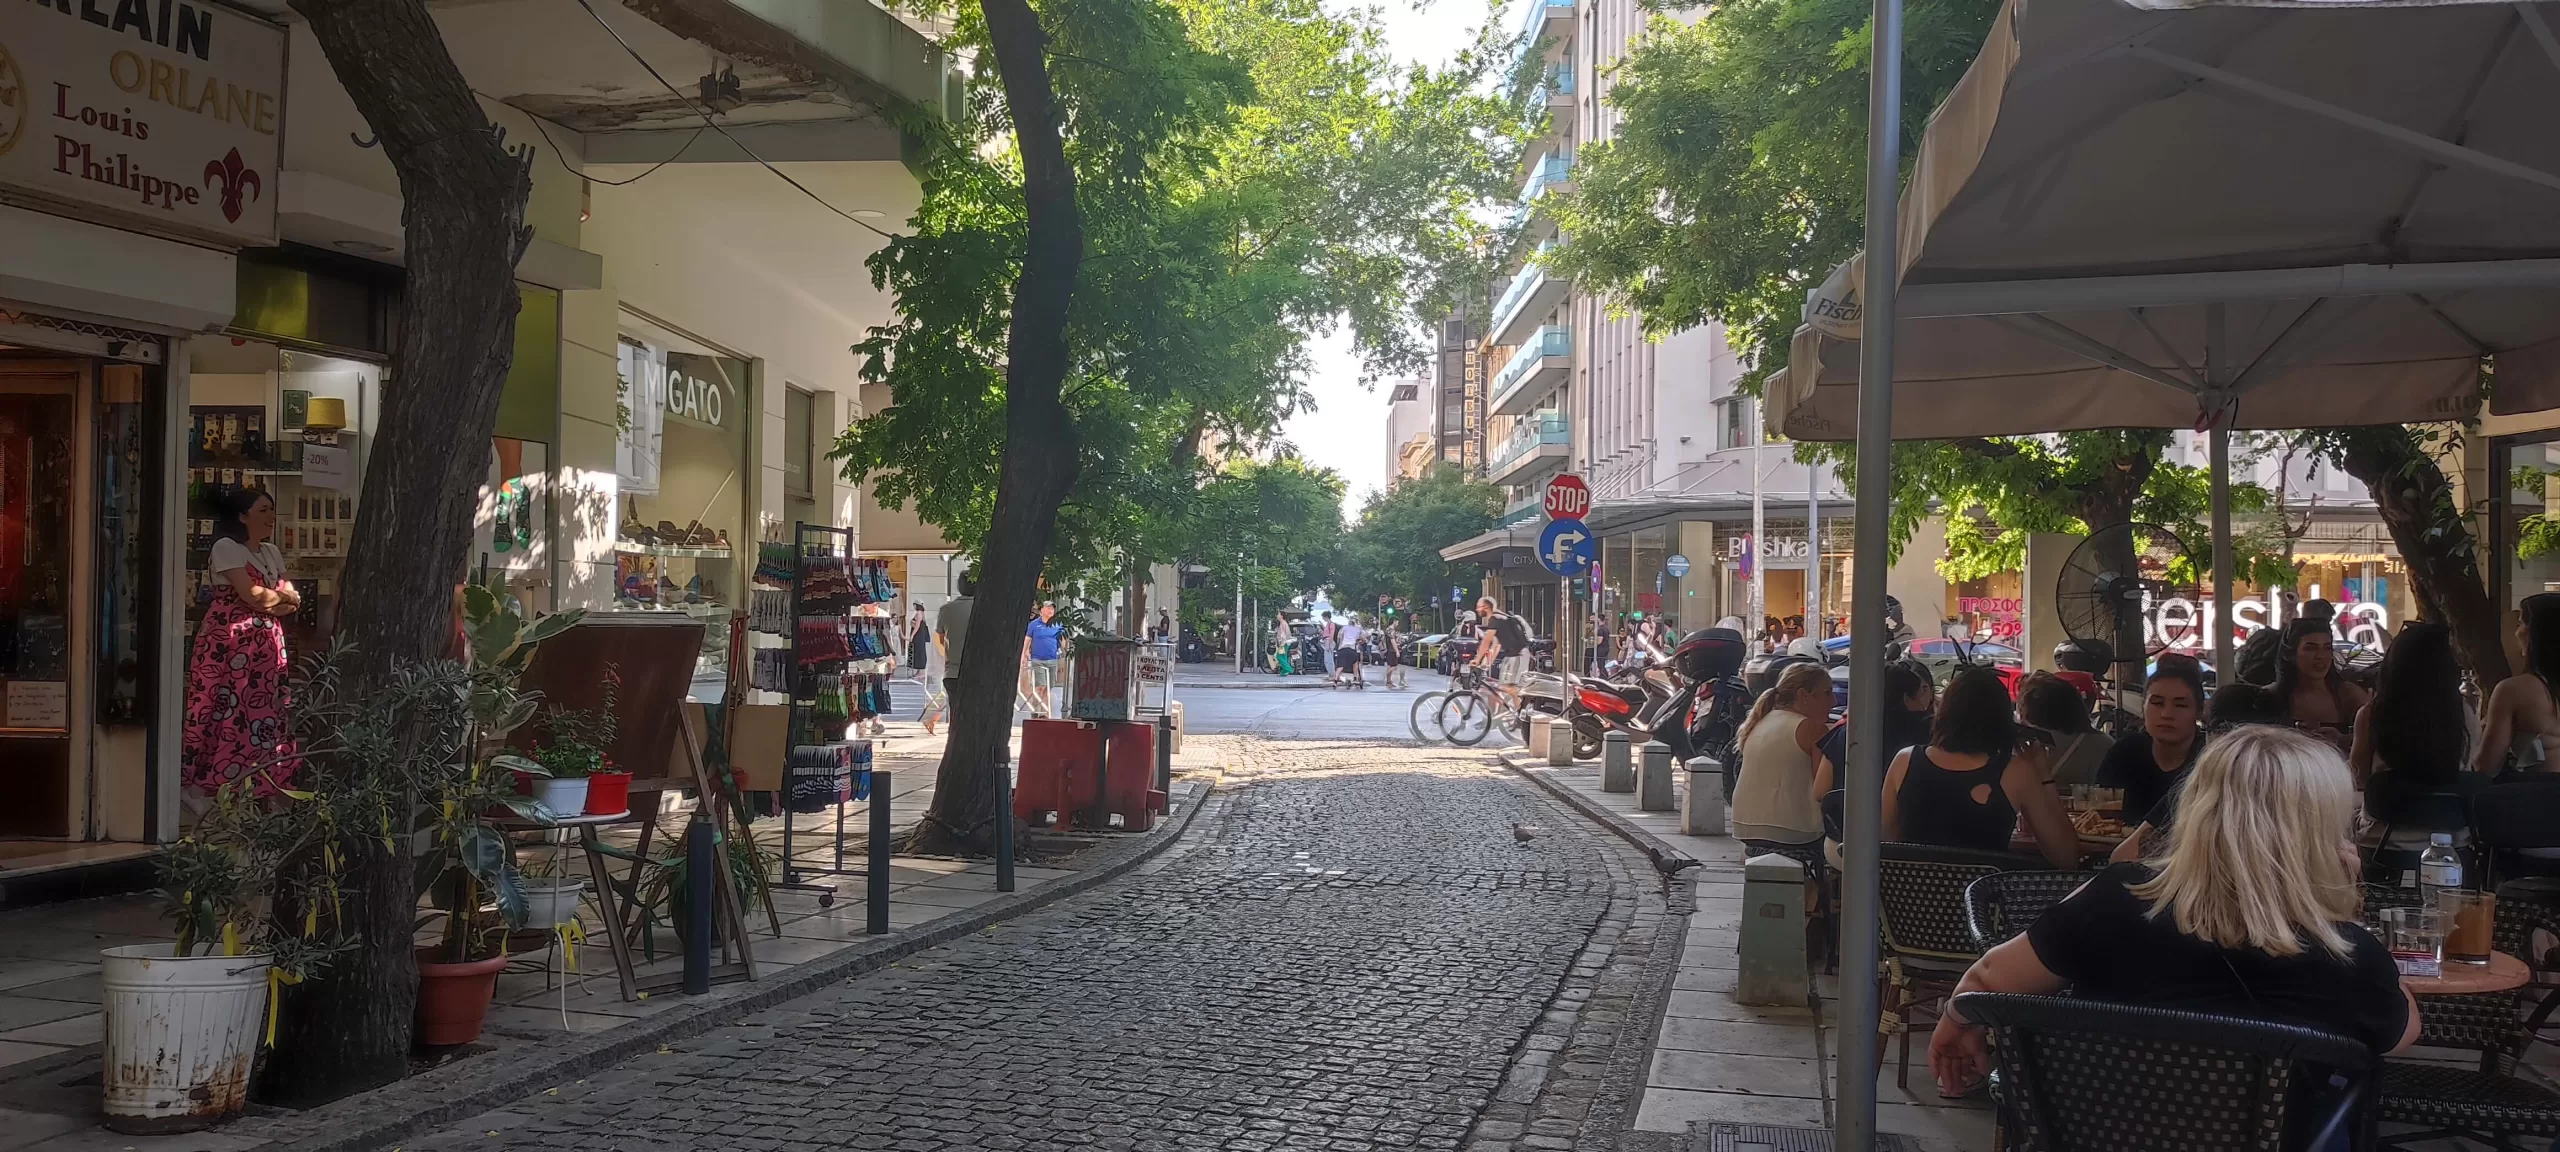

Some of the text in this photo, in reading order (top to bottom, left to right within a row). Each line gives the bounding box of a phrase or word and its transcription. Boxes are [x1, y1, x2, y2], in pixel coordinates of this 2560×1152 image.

[26, 0, 212, 61] LAIN
[53, 81, 149, 140] Louis
[109, 50, 275, 135] ORLANE
[53, 134, 200, 211] Philippe
[644, 359, 722, 426] MIGATO
[1466, 353, 1475, 427] HOTEL
[307, 453, 328, 466] -20%
[1546, 484, 1588, 514] STOP
[1728, 537, 1809, 557] Bshka
[1959, 598, 2023, 614] ΠΡΟΣΦΟ
